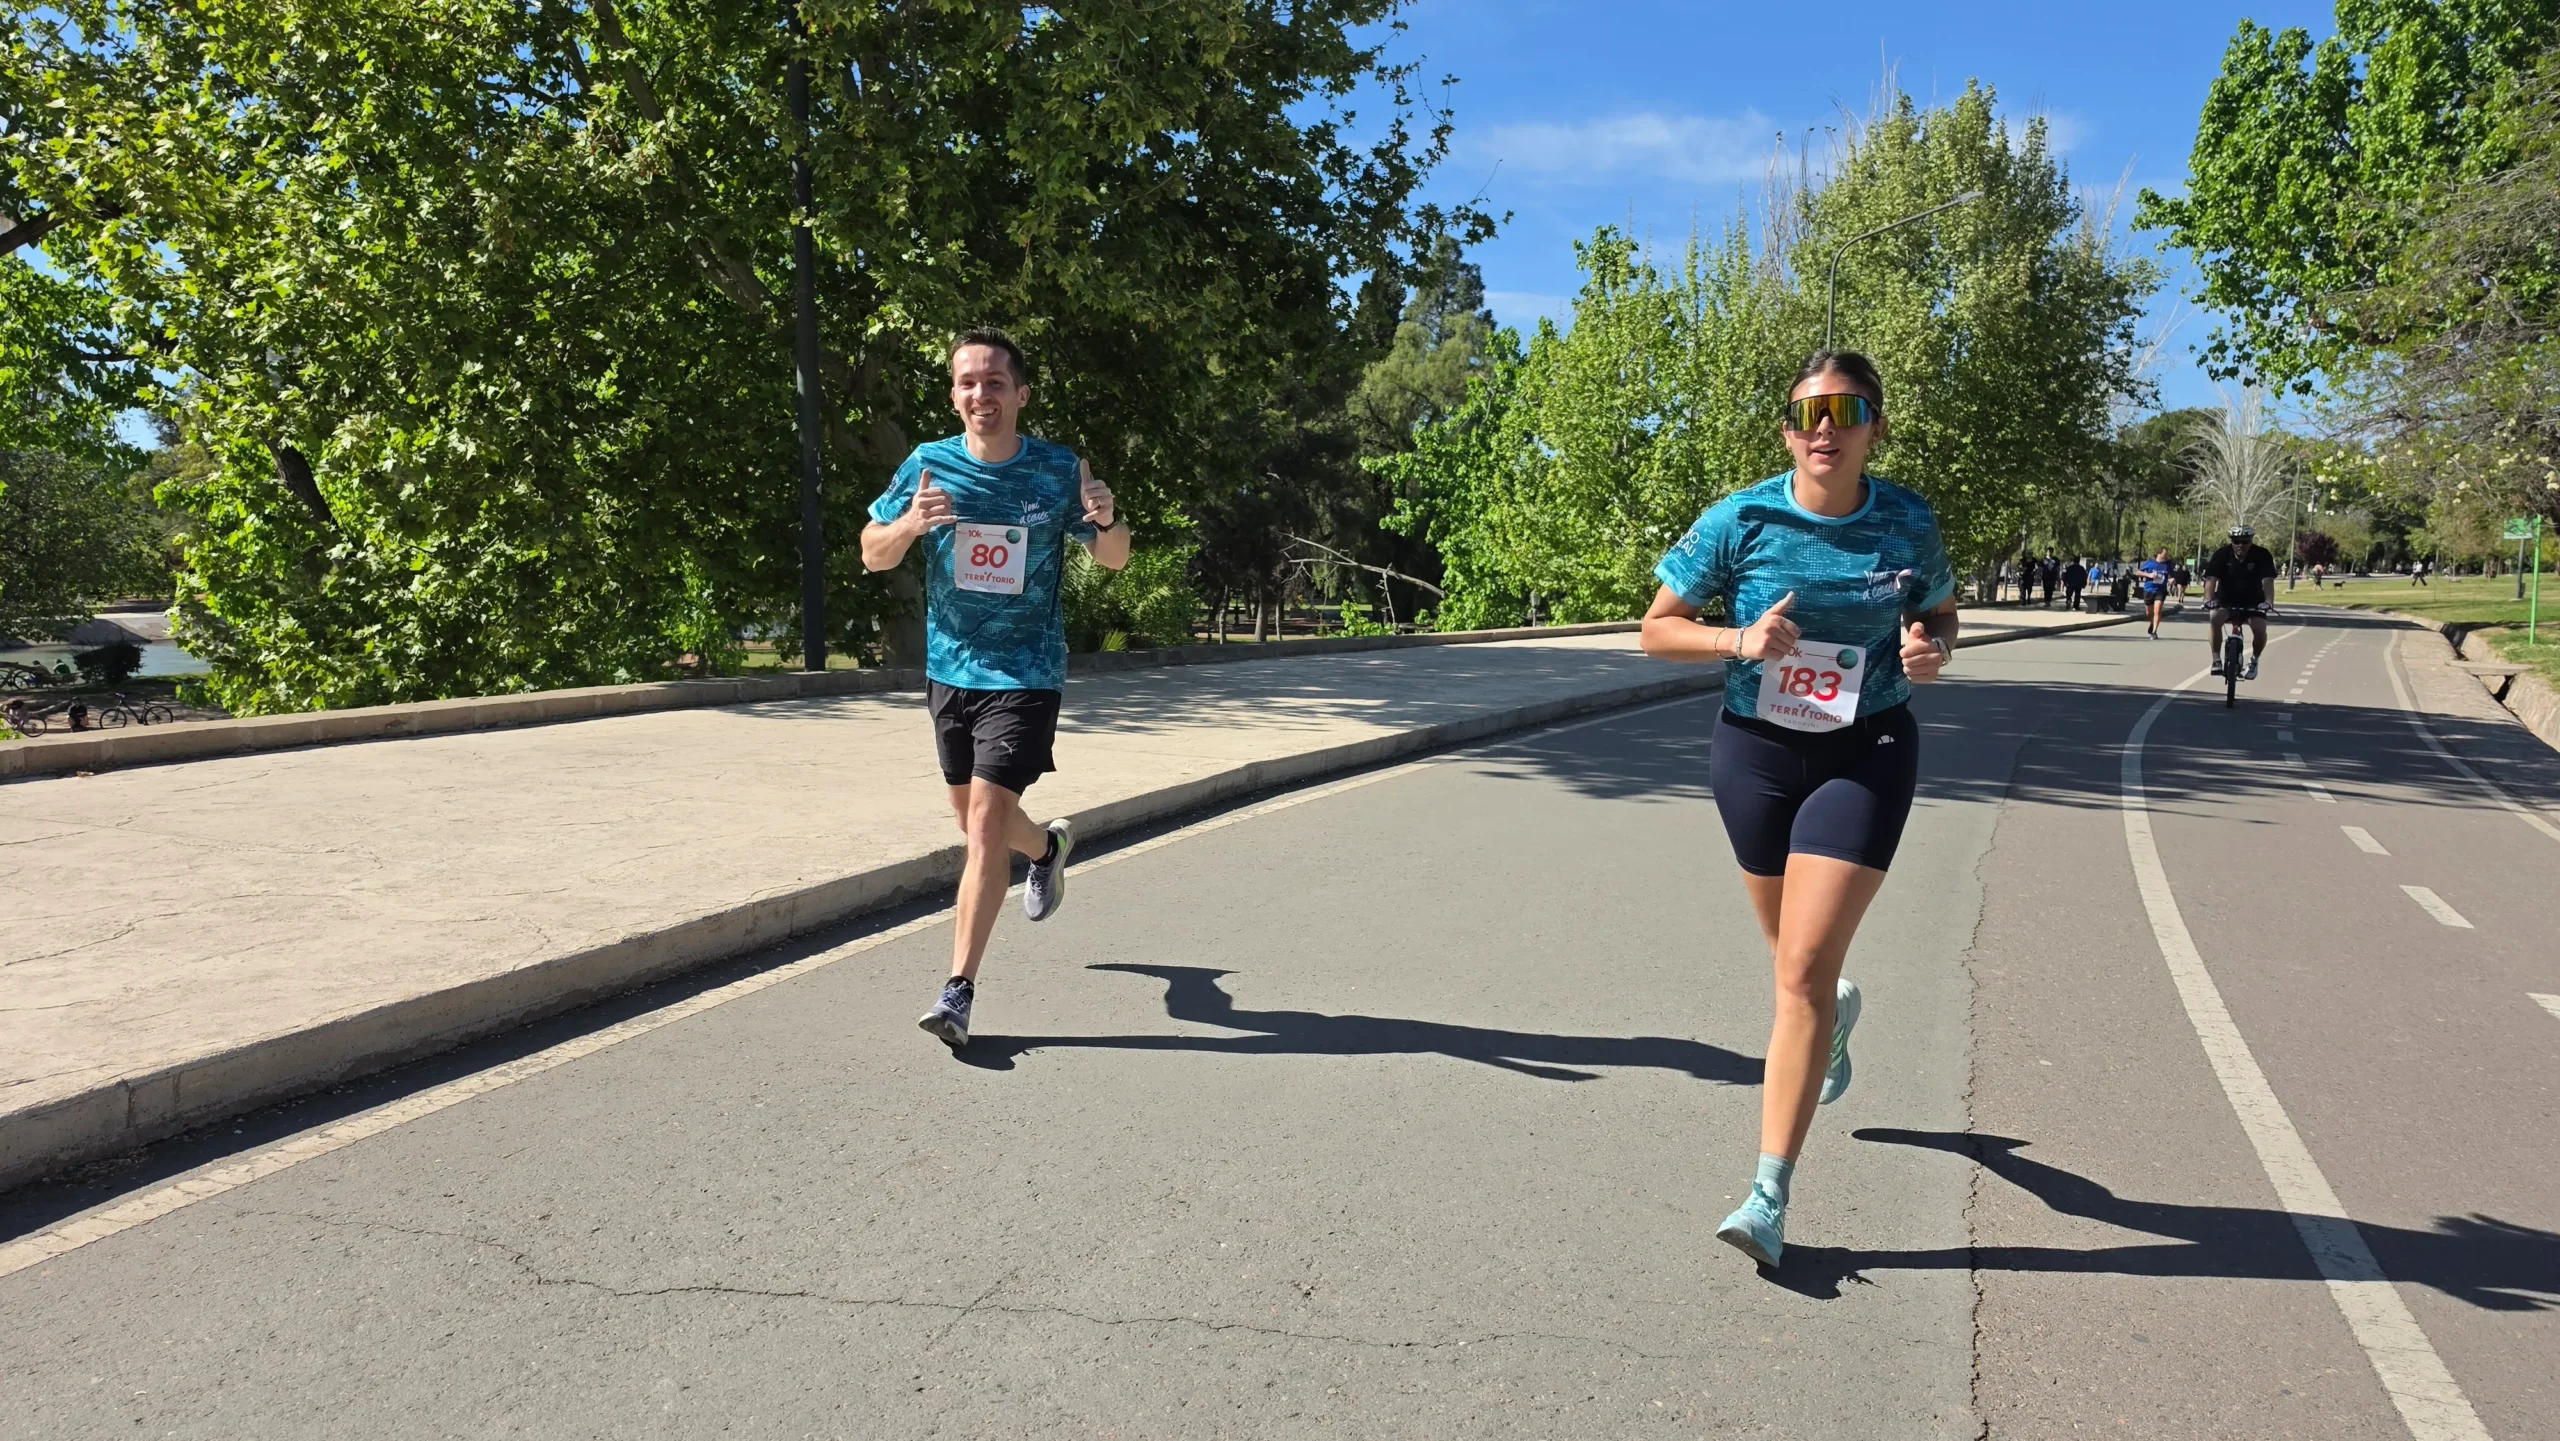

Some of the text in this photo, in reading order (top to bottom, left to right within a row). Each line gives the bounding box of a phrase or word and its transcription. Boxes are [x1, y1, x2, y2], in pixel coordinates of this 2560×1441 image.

[968, 530, 983, 539] 10k
[970, 544, 1009, 569] 80
[964, 572, 1015, 584] TERRITORIO
[1786, 646, 1803, 658] 0k
[1779, 666, 1842, 701] 183
[1770, 704, 1842, 723] TERRITORIO
